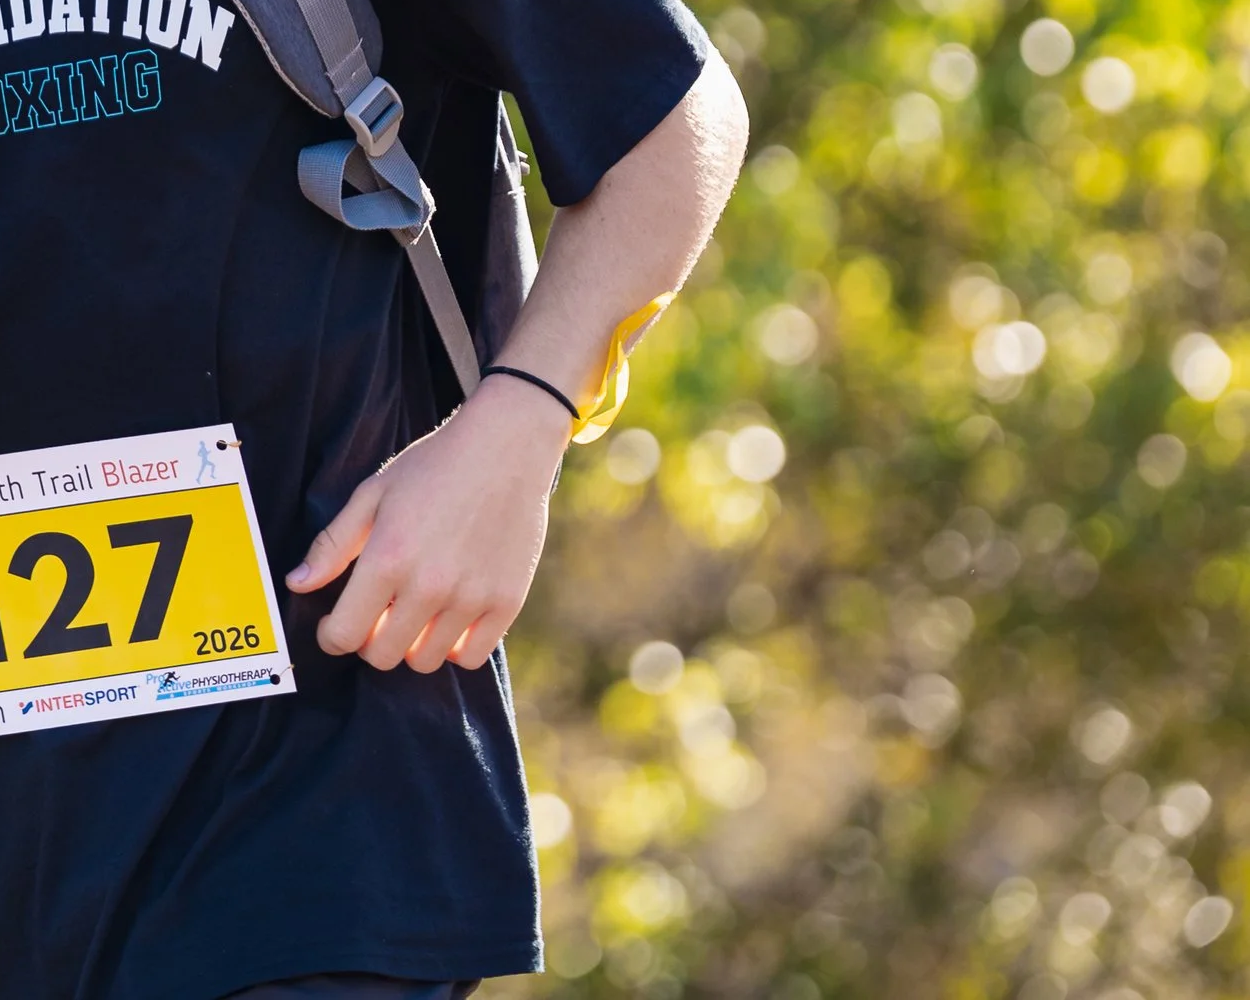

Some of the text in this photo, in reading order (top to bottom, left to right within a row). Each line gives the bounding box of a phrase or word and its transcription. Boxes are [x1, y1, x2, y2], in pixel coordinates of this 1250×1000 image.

[31, 464, 94, 497] Trail
[101, 459, 180, 488] Blazer
[193, 625, 260, 656] 2026
[35, 685, 138, 712] INTERSPORT
